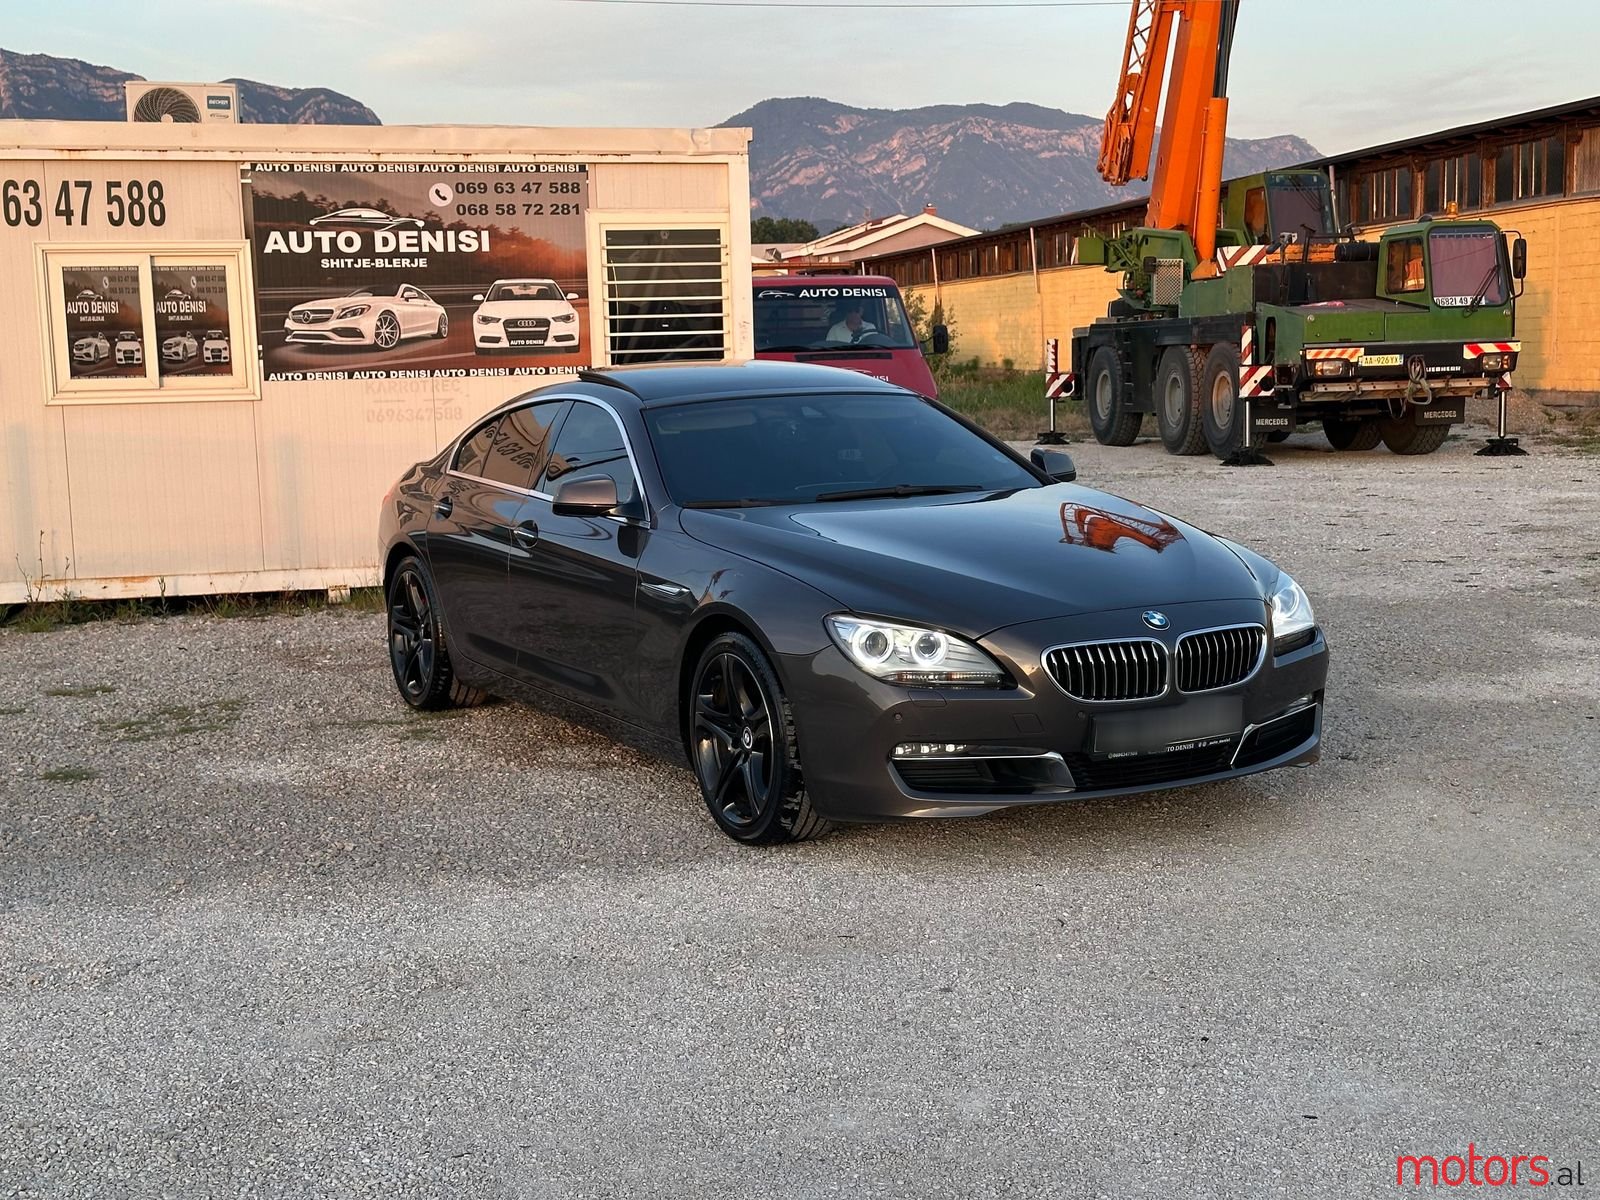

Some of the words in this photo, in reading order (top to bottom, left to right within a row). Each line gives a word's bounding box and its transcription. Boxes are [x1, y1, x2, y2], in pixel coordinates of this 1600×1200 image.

[255, 163, 290, 172] AUTO
[293, 163, 336, 172] DENISI
[340, 164, 374, 172] AUTO
[378, 164, 420, 172] DENISI
[422, 164, 456, 172] AUTO
[459, 164, 500, 173] DENISI
[503, 164, 537, 172] AUTO
[539, 164, 579, 172] DENISI
[455, 182, 488, 194] 069
[494, 182, 516, 194] 63
[521, 182, 543, 194] 47
[548, 182, 581, 194] 588
[2, 179, 43, 227] 63
[54, 180, 93, 226] 47
[106, 180, 166, 227] 588
[456, 203, 489, 216] 068
[495, 203, 516, 215] 58
[522, 203, 544, 215] 72
[549, 203, 580, 215] 281
[263, 230, 362, 254] AUTO
[374, 230, 490, 253] DENISI
[320, 258, 428, 268] SHITJE-BLERJE
[799, 288, 839, 298] AUTO
[842, 288, 887, 297] DENISI
[67, 301, 89, 314] AUTO
[91, 301, 119, 314] DENISI
[155, 301, 178, 314] AUTO
[179, 301, 207, 313] DENISI
[268, 373, 303, 381] AUTO
[306, 372, 348, 380] DENISI
[352, 371, 387, 379] AUTO
[390, 370, 431, 379] DENISI
[433, 368, 466, 377] AUTO
[469, 367, 510, 376] DENISI
[513, 367, 546, 375] AUTO
[1423, 410, 1457, 419] MERCEDES
[1255, 418, 1289, 426] MERCEDES
